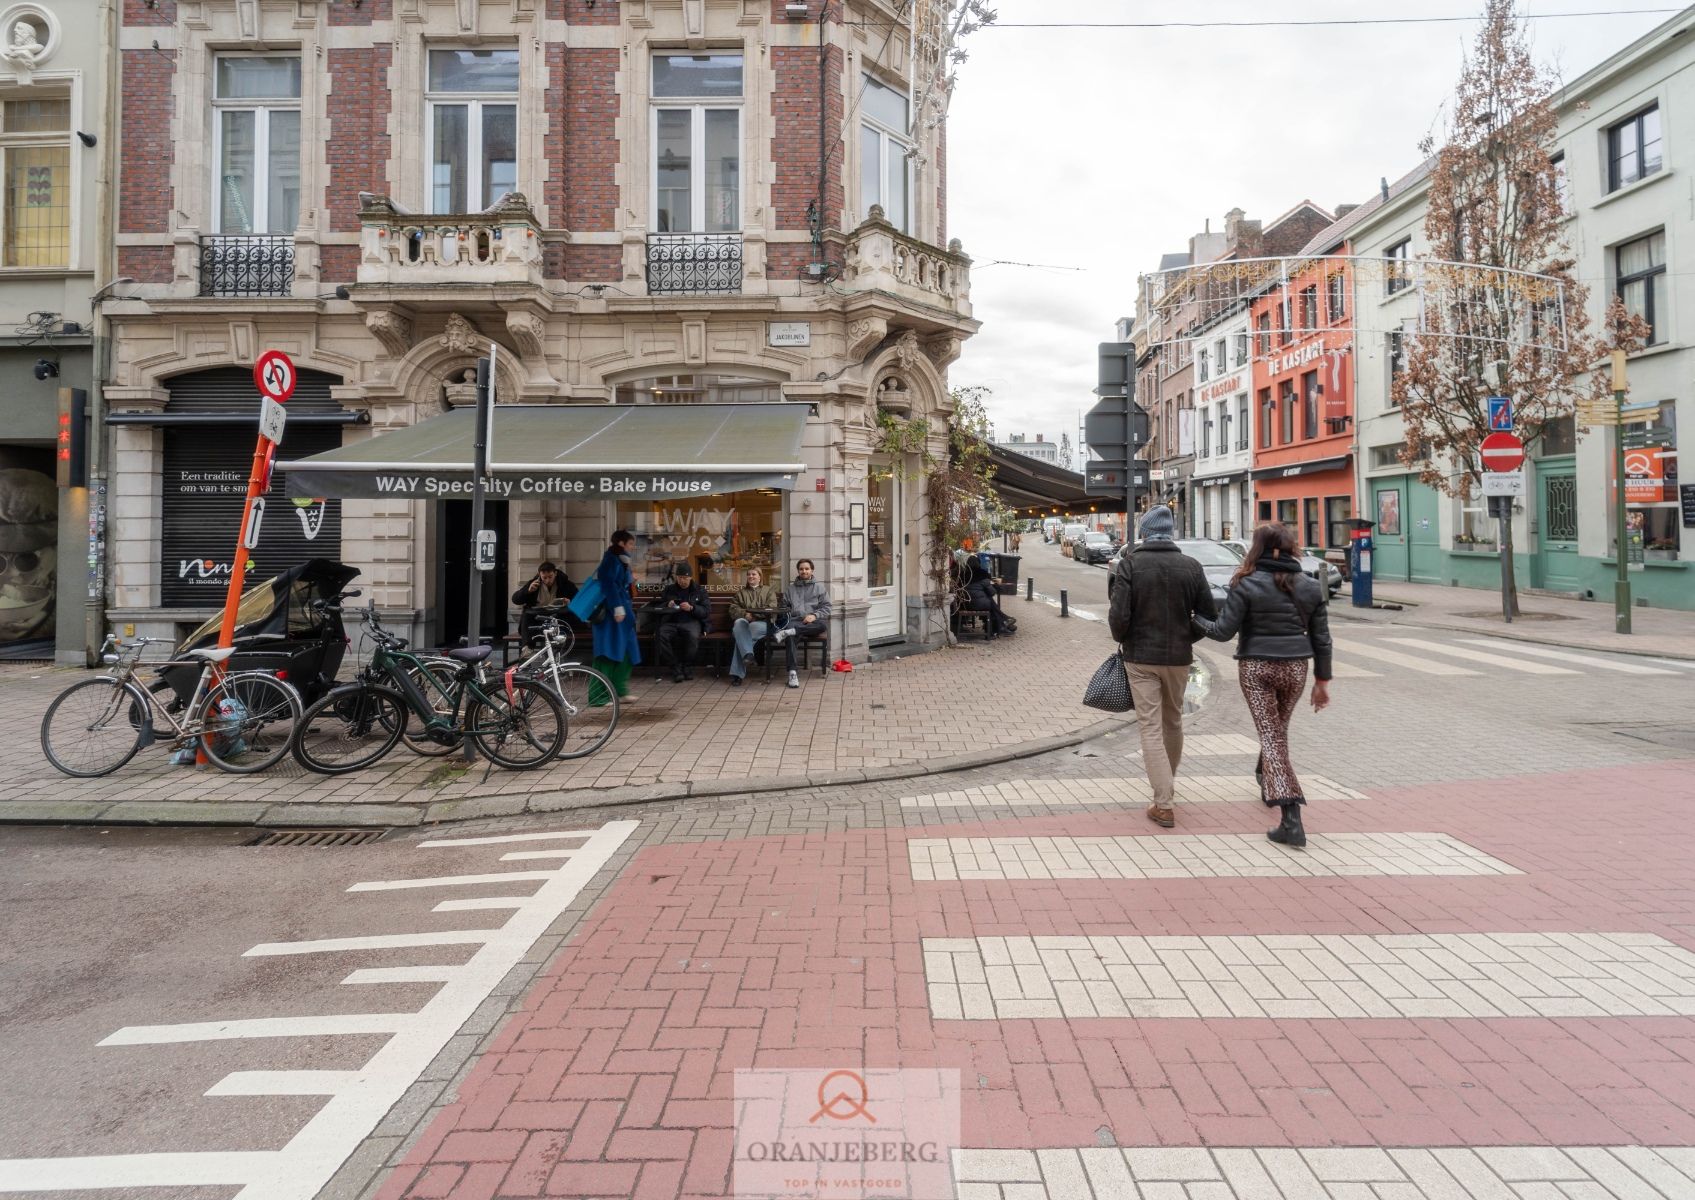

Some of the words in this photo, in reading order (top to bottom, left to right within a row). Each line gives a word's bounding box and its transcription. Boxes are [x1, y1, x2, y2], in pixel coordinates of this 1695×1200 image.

[1268, 359, 1280, 376] DE
[1282, 338, 1325, 372] KASTART
[181, 471, 201, 481] Een
[204, 471, 241, 481] traditie
[180, 484, 196, 492] om
[199, 484, 218, 492] van
[220, 483, 230, 492] te
[375, 476, 420, 492] WAY
[424, 477, 513, 496] Specalty
[520, 477, 584, 493] Coffee
[600, 477, 647, 492] Bake
[652, 477, 712, 492] House
[868, 496, 886, 507] WAY
[663, 507, 736, 533] WAY
[717, 584, 745, 592] ROAST
